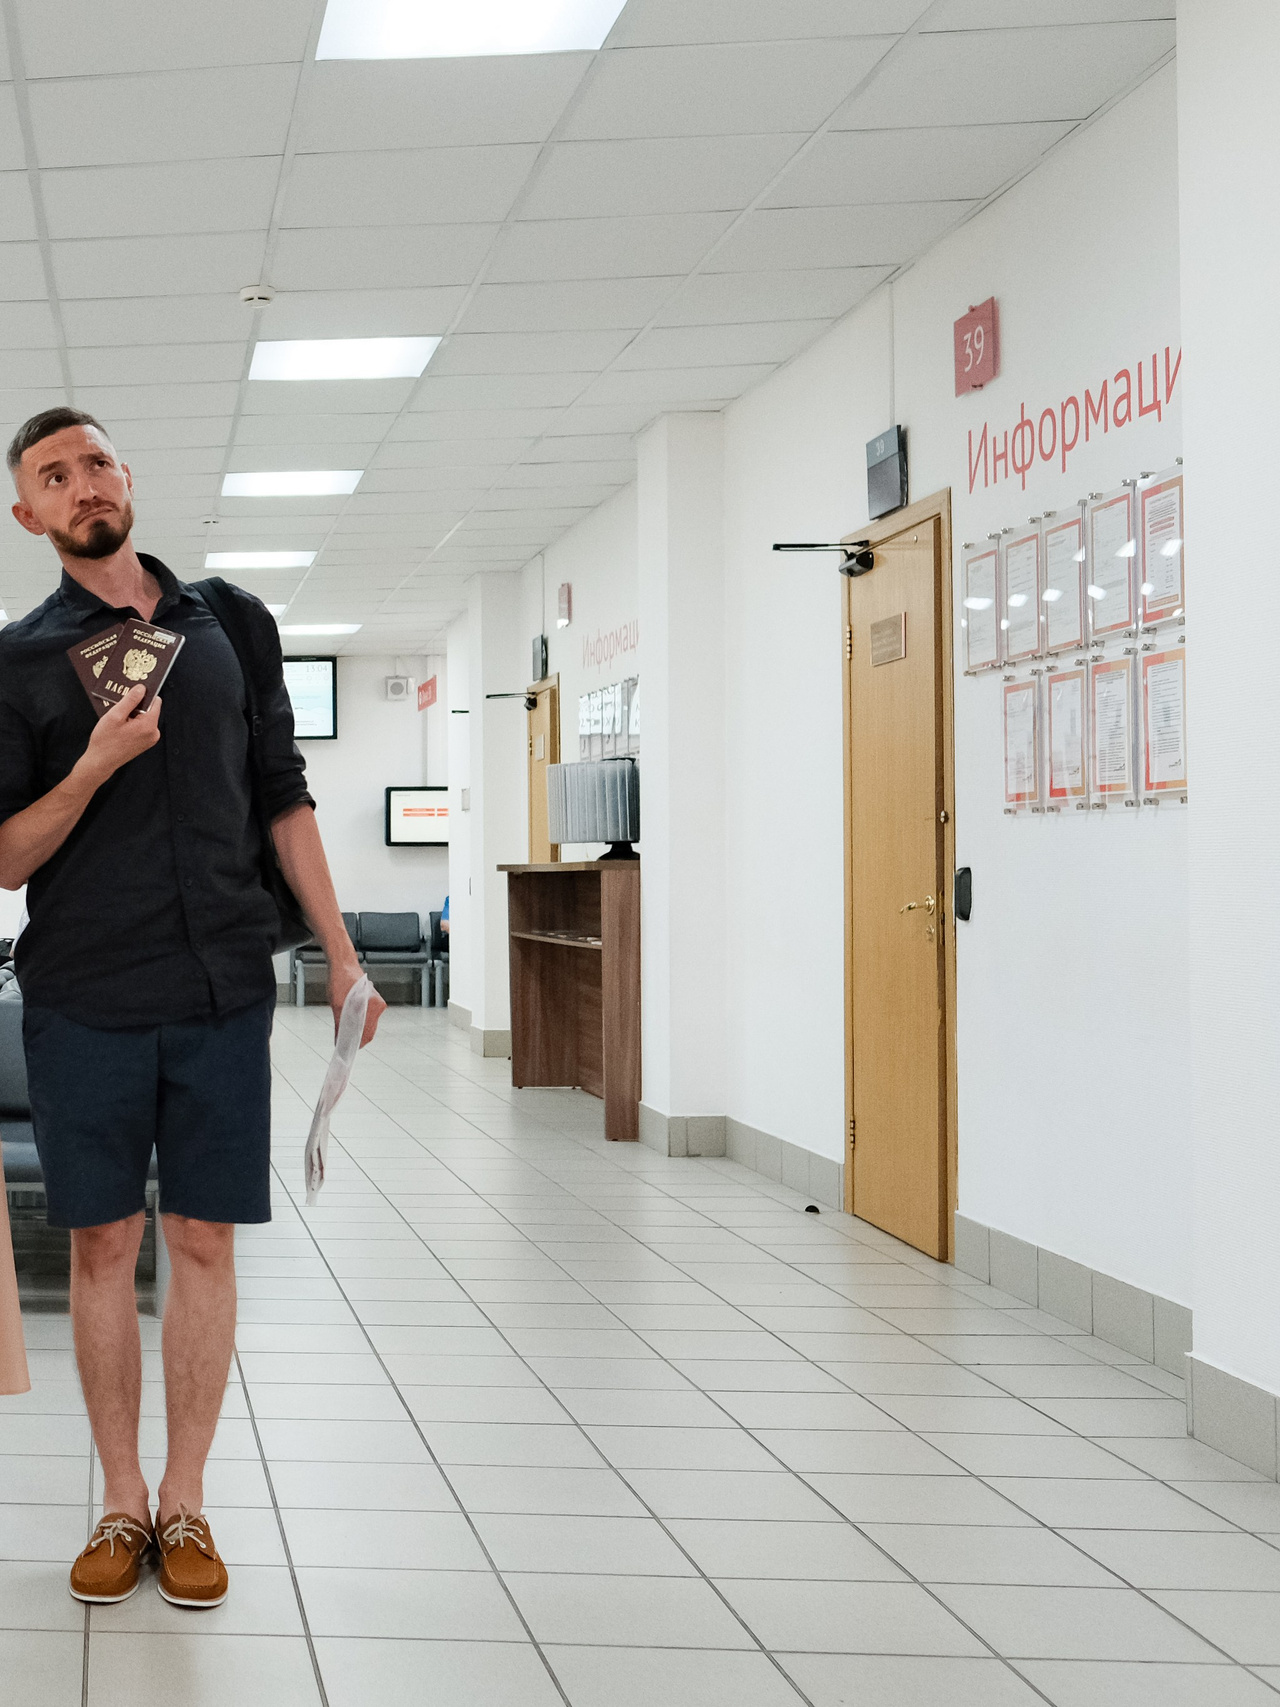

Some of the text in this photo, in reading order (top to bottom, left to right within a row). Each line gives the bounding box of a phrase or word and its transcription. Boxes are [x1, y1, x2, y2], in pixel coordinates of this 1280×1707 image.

[963, 325, 985, 373] 39
[967, 346, 1182, 495] Информаци
[876, 439, 885, 457] 39
[80, 633, 118, 656] РОССИЙСКАЯ
[84, 639, 118, 659] ФЕДЕРАЦИЯ
[132, 634, 166, 650] ФЕДЕРАЦИЯ
[306, 664, 328, 673] 13:04
[104, 680, 131, 697] ПАСП
